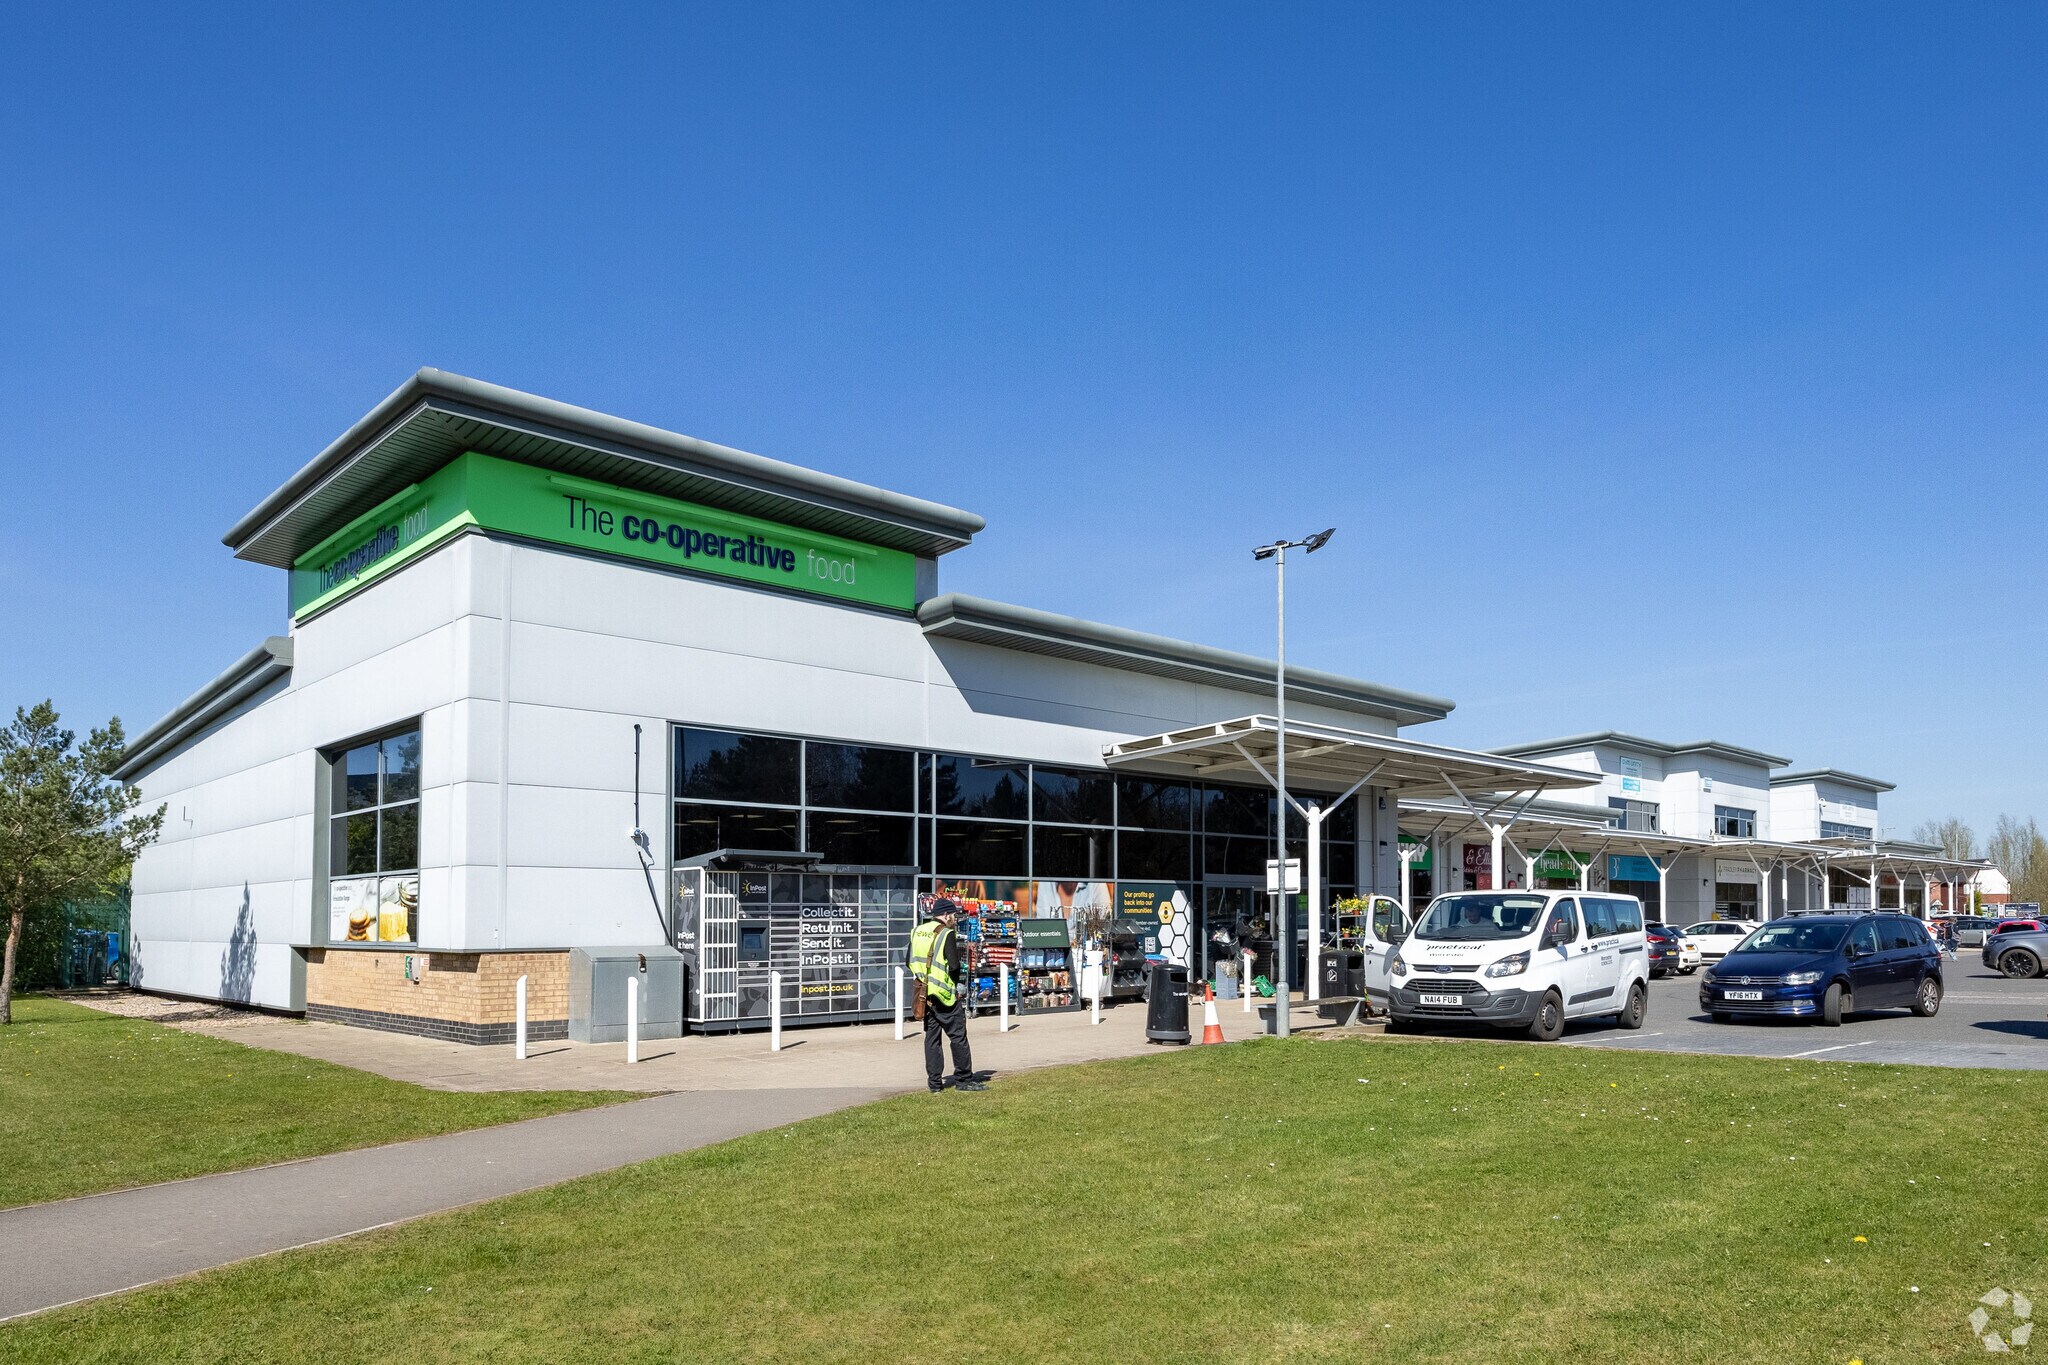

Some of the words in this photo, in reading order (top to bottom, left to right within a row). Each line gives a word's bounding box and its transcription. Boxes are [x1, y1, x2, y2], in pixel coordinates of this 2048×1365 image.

[563, 495, 614, 536] The
[622, 515, 796, 573] co-operative
[806, 548, 856, 586] food
[319, 564, 334, 593] The
[403, 499, 429, 543] food
[1133, 891, 1148, 899] profits
[802, 907, 843, 917] Collect
[844, 907, 856, 917] it.
[802, 923, 843, 933] Return
[843, 923, 855, 933] it.
[678, 931, 695, 939] InPost
[683, 942, 695, 950] here
[802, 938, 832, 948] Send
[833, 938, 845, 948] it.
[801, 954, 843, 964] InPost
[844, 953, 855, 963] it.
[801, 984, 854, 994] inpost.co.uk
[1442, 996, 1458, 1004] FUB
